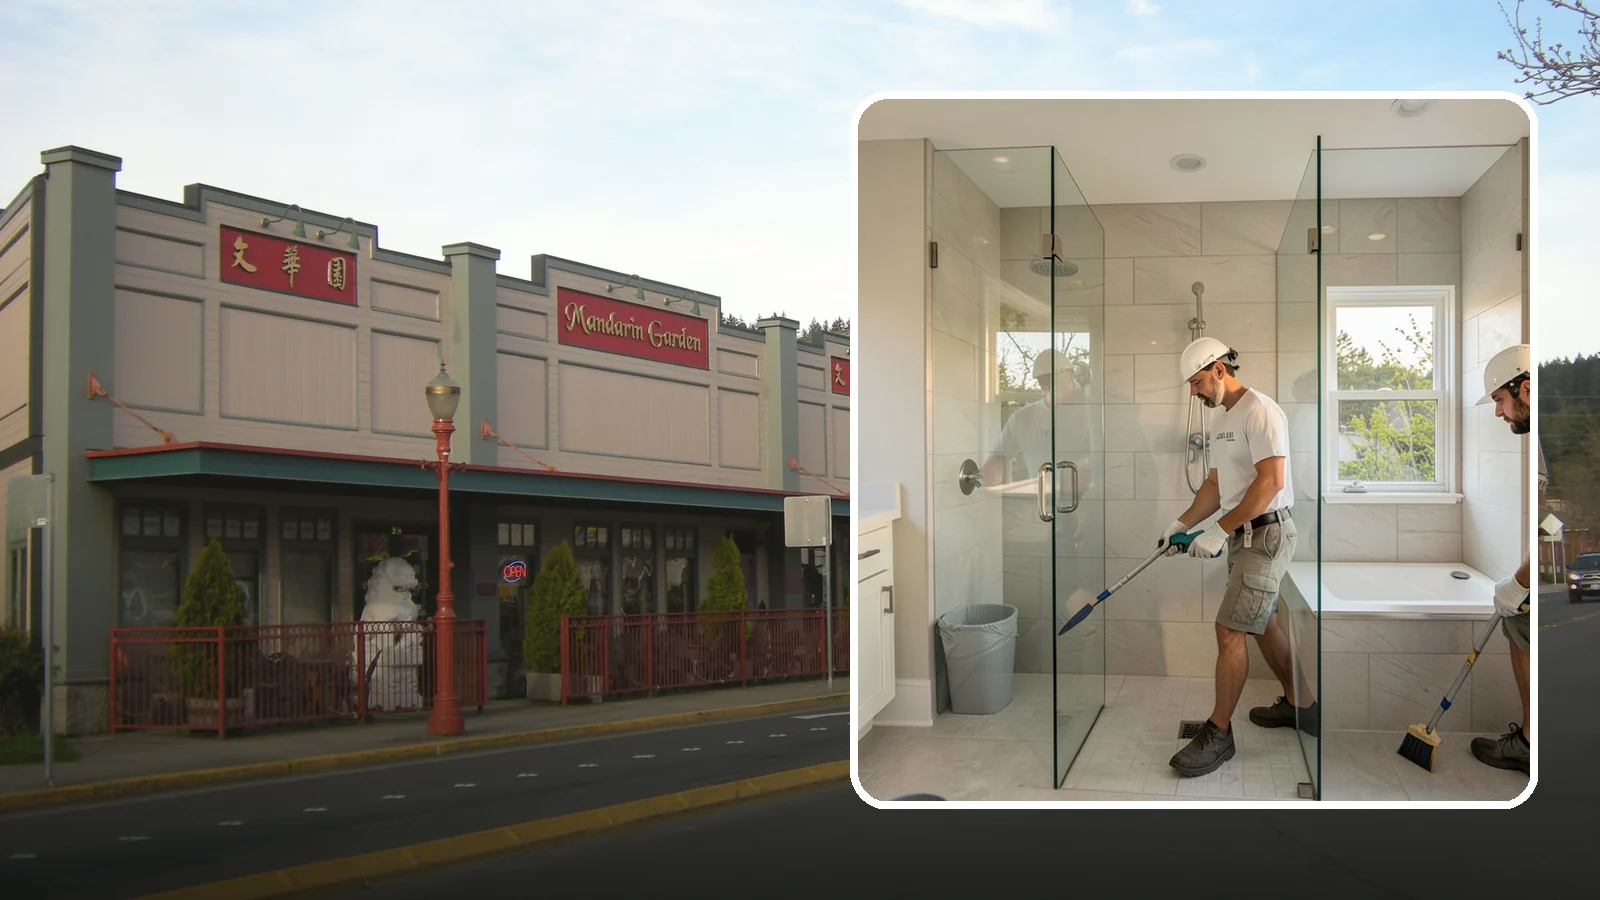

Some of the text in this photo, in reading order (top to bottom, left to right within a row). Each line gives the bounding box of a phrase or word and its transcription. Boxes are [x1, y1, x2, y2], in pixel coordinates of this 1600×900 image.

[231, 235, 346, 291] 文華園
[564, 302, 702, 352] Mandarin Garden
[834, 363, 846, 387] 文
[503, 565, 527, 578] OPEN
